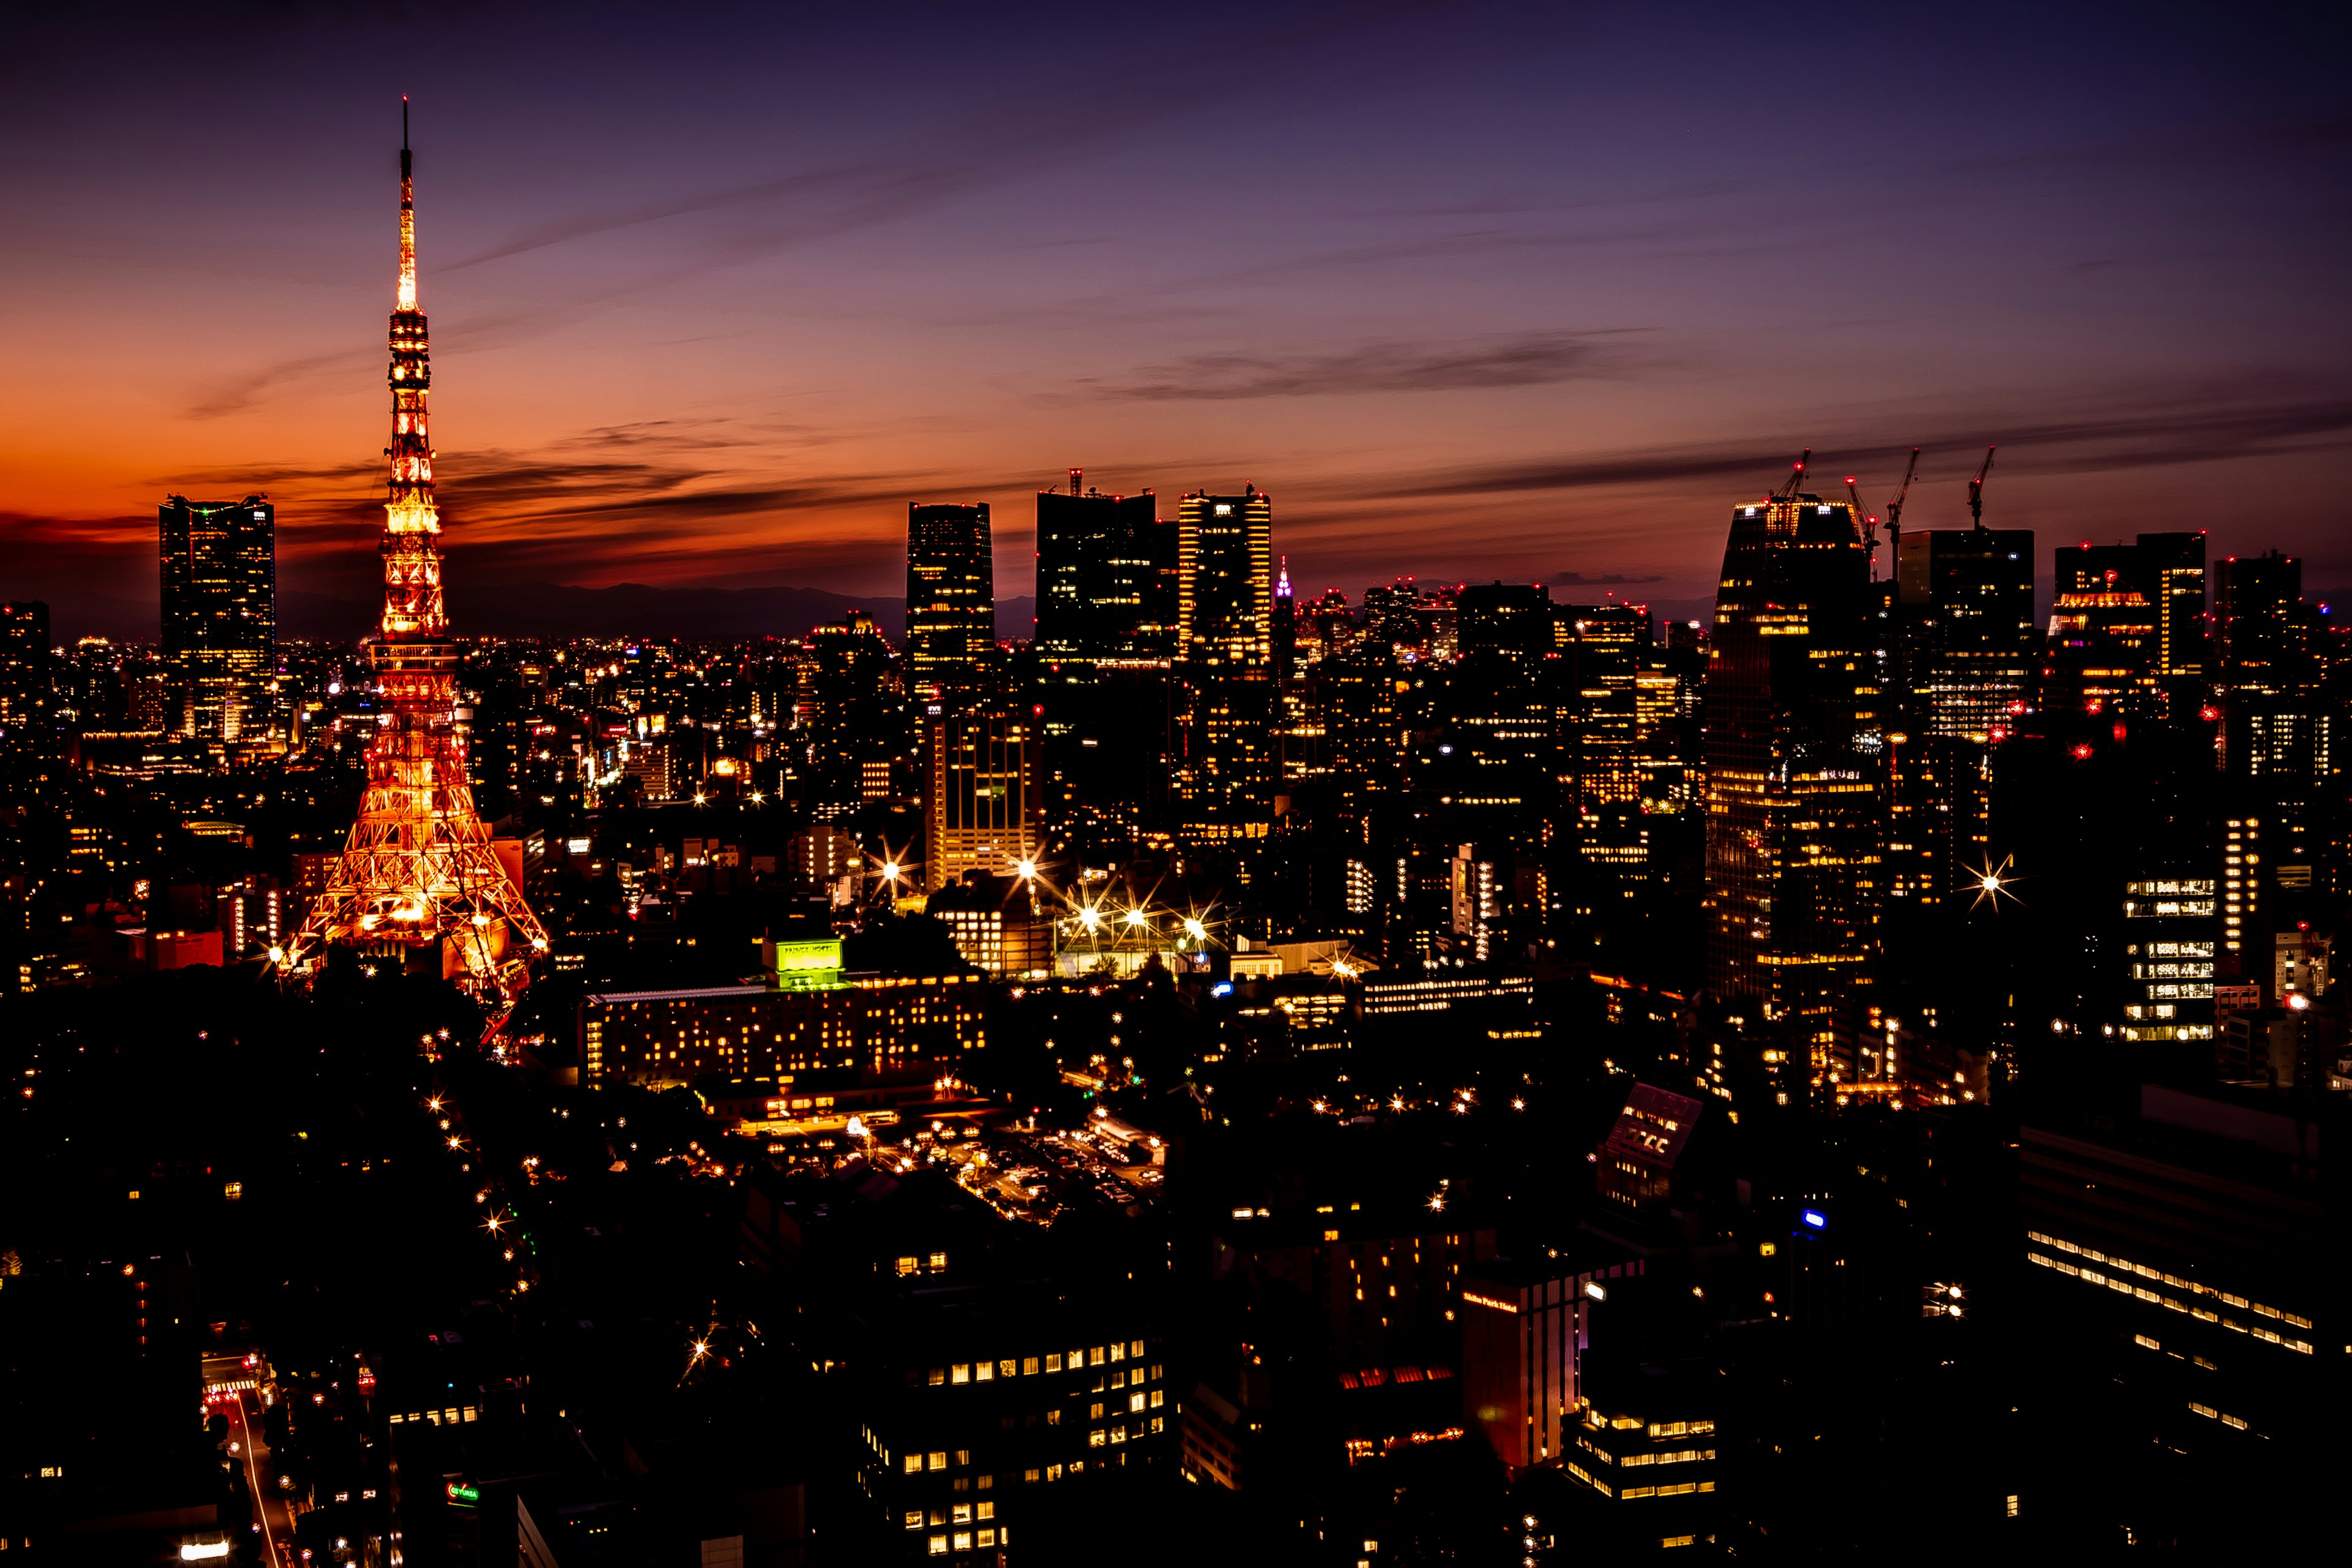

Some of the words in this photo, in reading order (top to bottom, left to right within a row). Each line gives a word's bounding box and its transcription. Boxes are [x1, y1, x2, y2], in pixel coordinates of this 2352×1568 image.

[1463, 1292, 1482, 1304] Shiba
[1482, 1297, 1499, 1308] Park
[1499, 1302, 1517, 1313] Hotel
